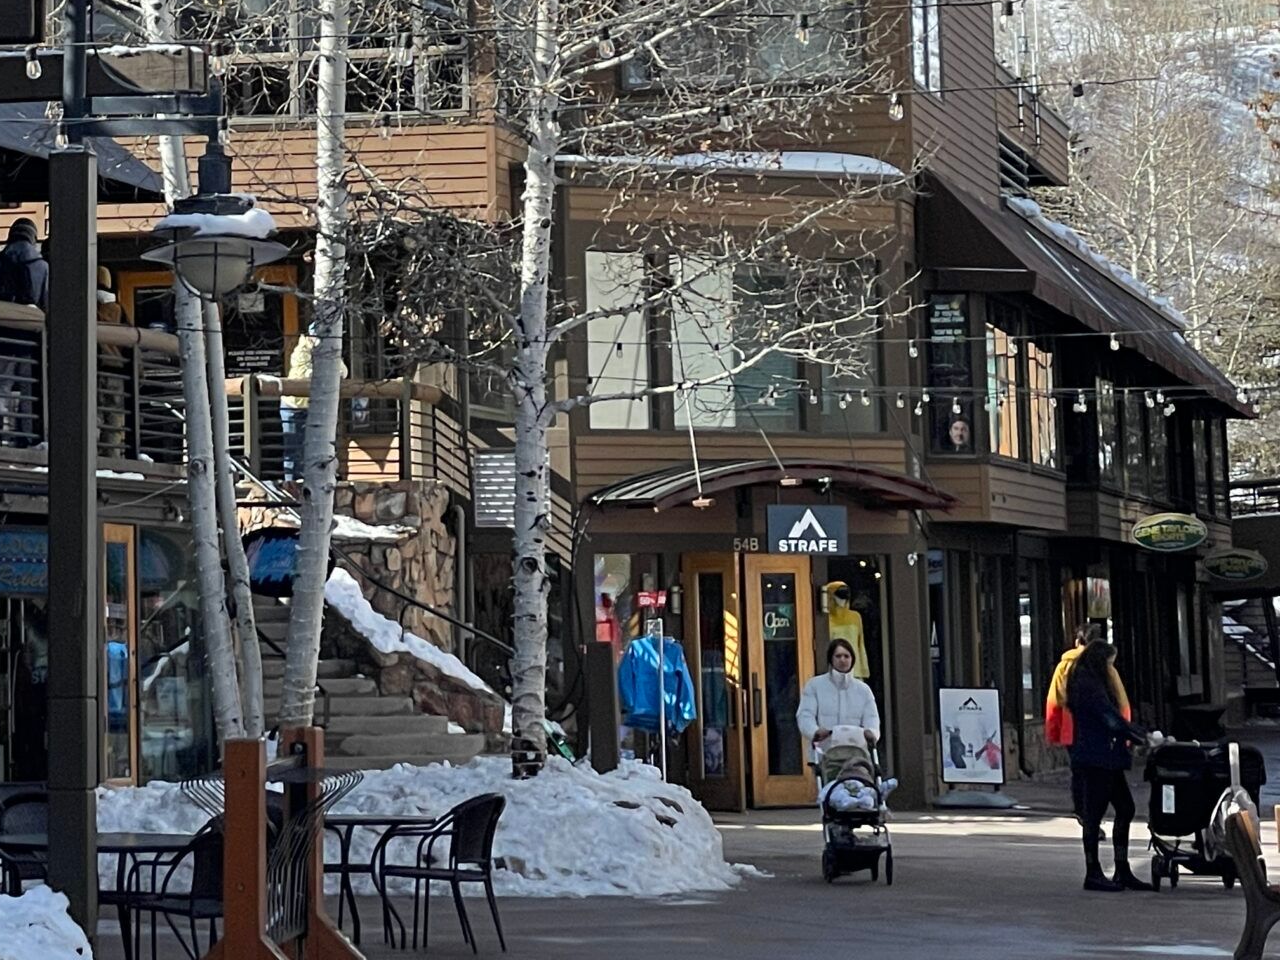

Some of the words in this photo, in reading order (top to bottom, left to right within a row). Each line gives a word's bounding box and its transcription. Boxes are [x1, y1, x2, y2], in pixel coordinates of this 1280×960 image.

[733, 537, 759, 552] 54B
[778, 539, 838, 553] STRAFE
[763, 611, 790, 637] Open
